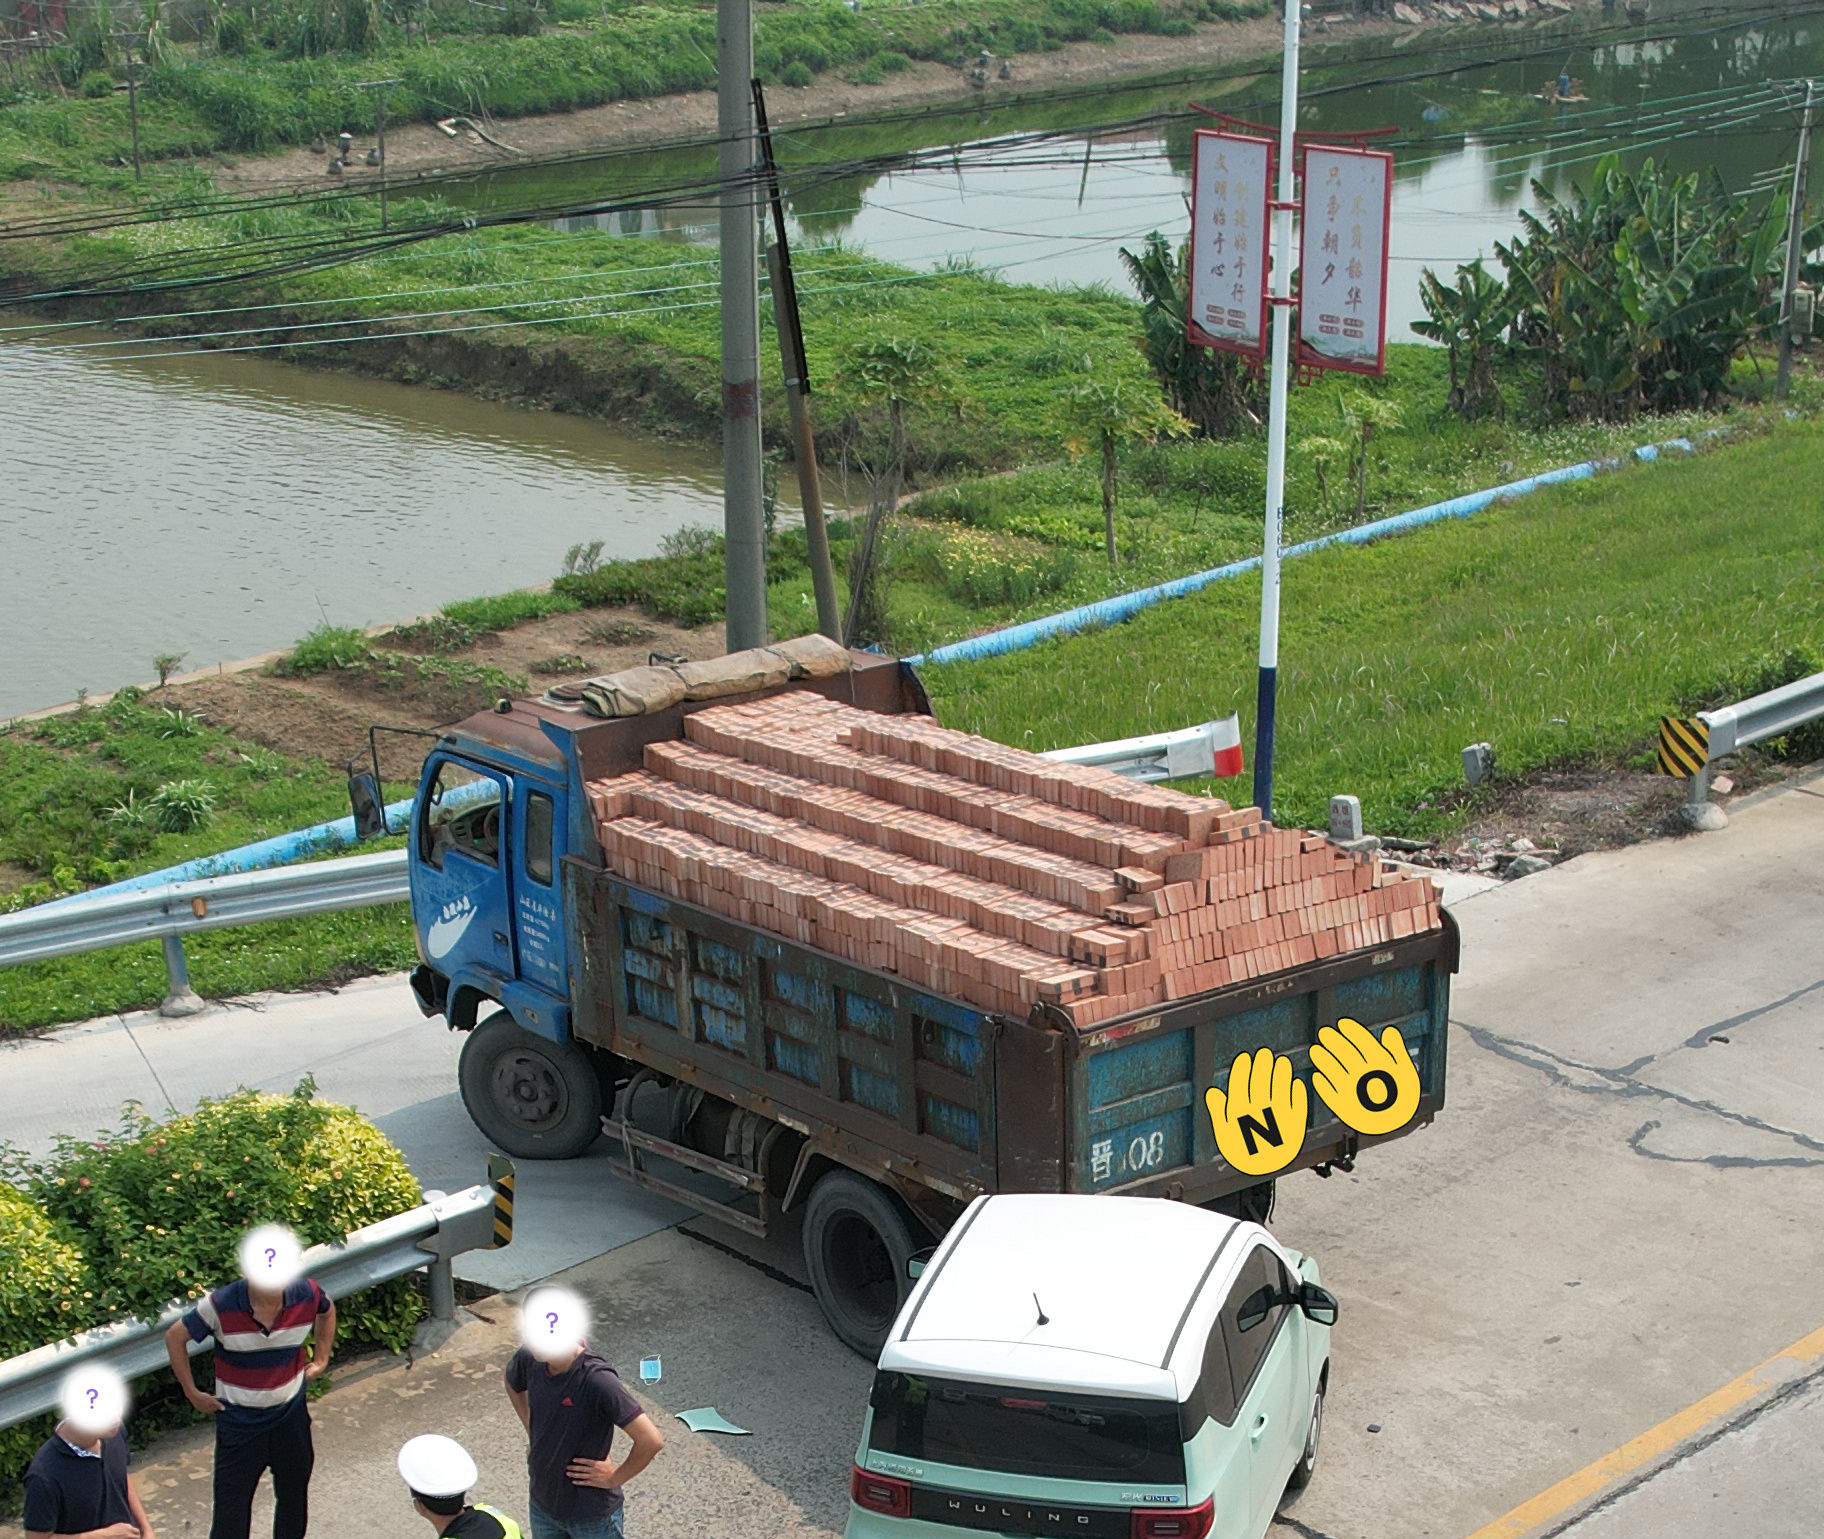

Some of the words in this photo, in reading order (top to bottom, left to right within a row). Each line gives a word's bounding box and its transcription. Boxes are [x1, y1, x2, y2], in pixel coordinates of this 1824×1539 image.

[1211, 153, 1229, 278] 文明始于心
[1321, 166, 1341, 285] 只争朝夕
[1345, 196, 1366, 312] 不负韶华
[948, 1499, 1089, 1524] WULING
